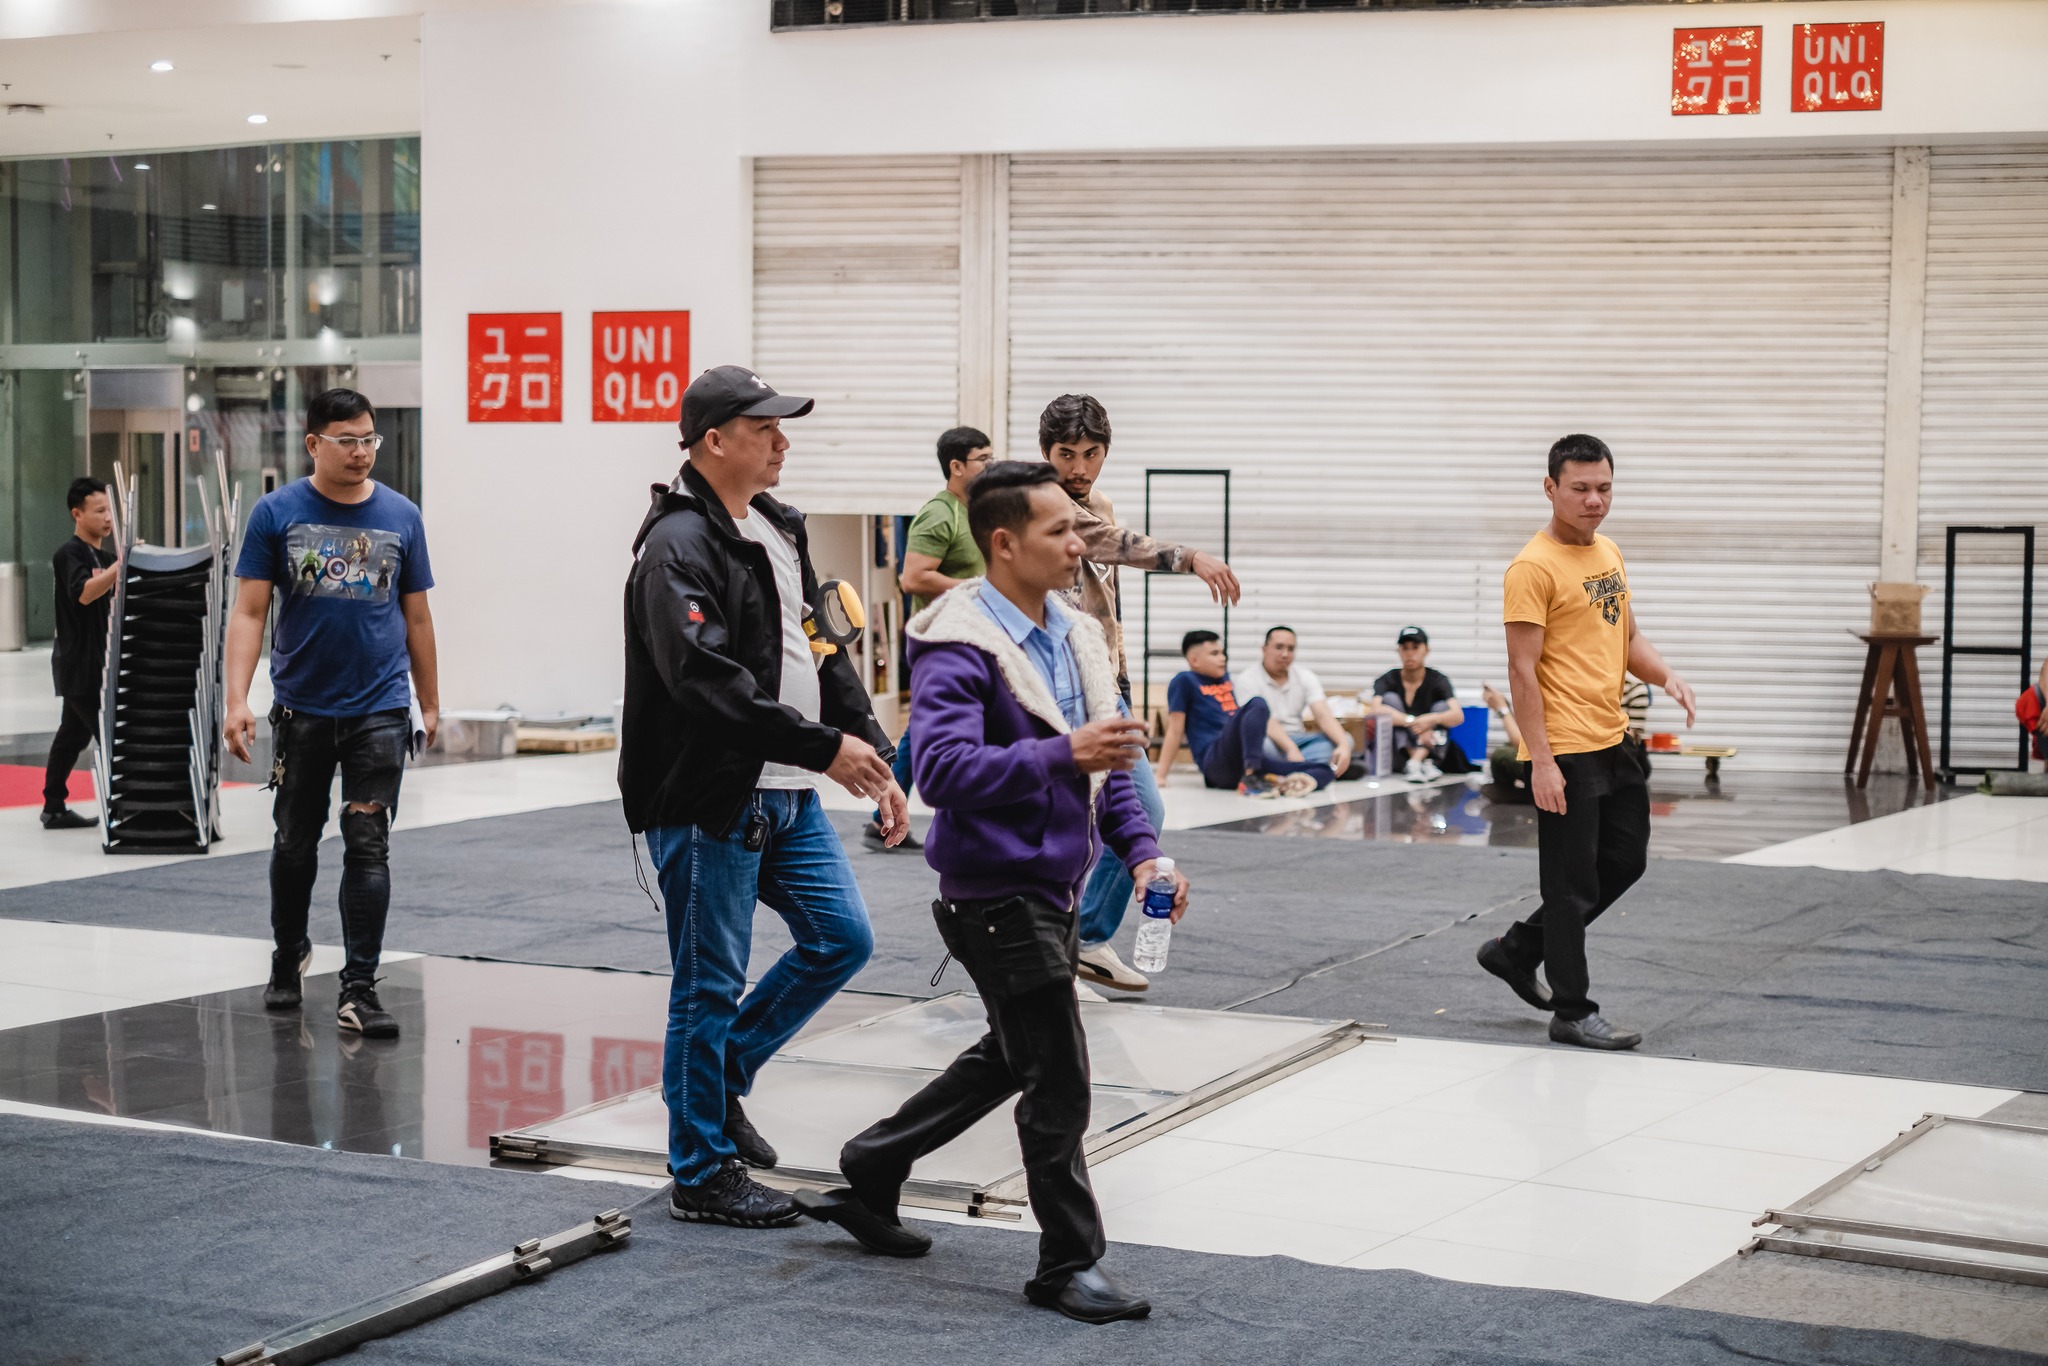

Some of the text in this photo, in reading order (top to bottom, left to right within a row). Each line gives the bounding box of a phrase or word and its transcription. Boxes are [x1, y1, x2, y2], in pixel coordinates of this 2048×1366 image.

[1687, 38, 1750, 68] ユニ
[1803, 35, 1866, 65] UNI
[1686, 75, 1749, 103] クロ
[1802, 70, 1871, 105] QLO
[482, 327, 550, 363] ユニ
[603, 326, 671, 363] UNI
[480, 373, 550, 409] クロ
[603, 371, 678, 415] QLO
